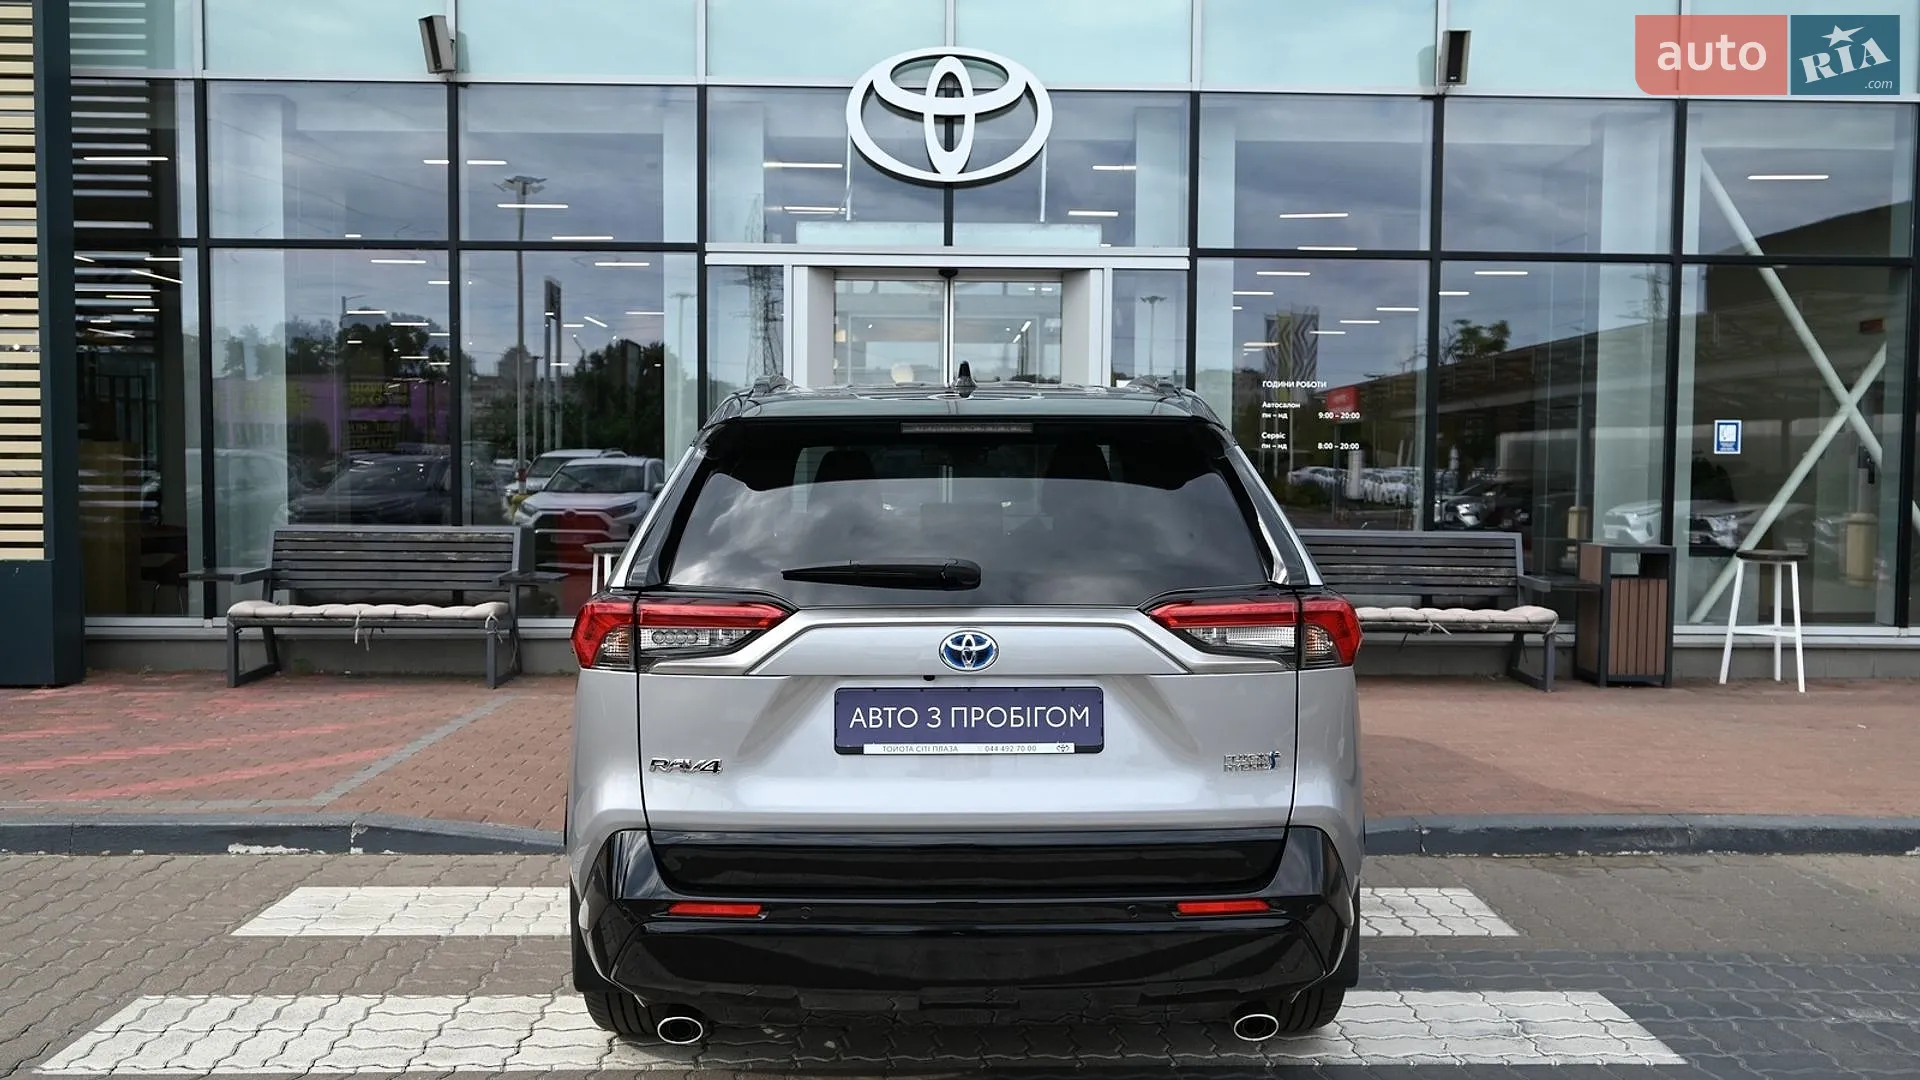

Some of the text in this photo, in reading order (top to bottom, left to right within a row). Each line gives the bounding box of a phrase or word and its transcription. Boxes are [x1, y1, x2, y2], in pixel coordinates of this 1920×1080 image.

[1262, 380, 1327, 388] ГОДИНИ РОБОТИ
[1262, 401, 1300, 409] Автосалон
[1318, 411, 1334, 419] 9:00
[1340, 411, 1360, 419] 20:00
[1261, 432, 1286, 440] Сервіс
[849, 706, 919, 729] АВТО
[951, 706, 1090, 728] ПРОБІГОМ
[650, 758, 723, 774] RAV4
